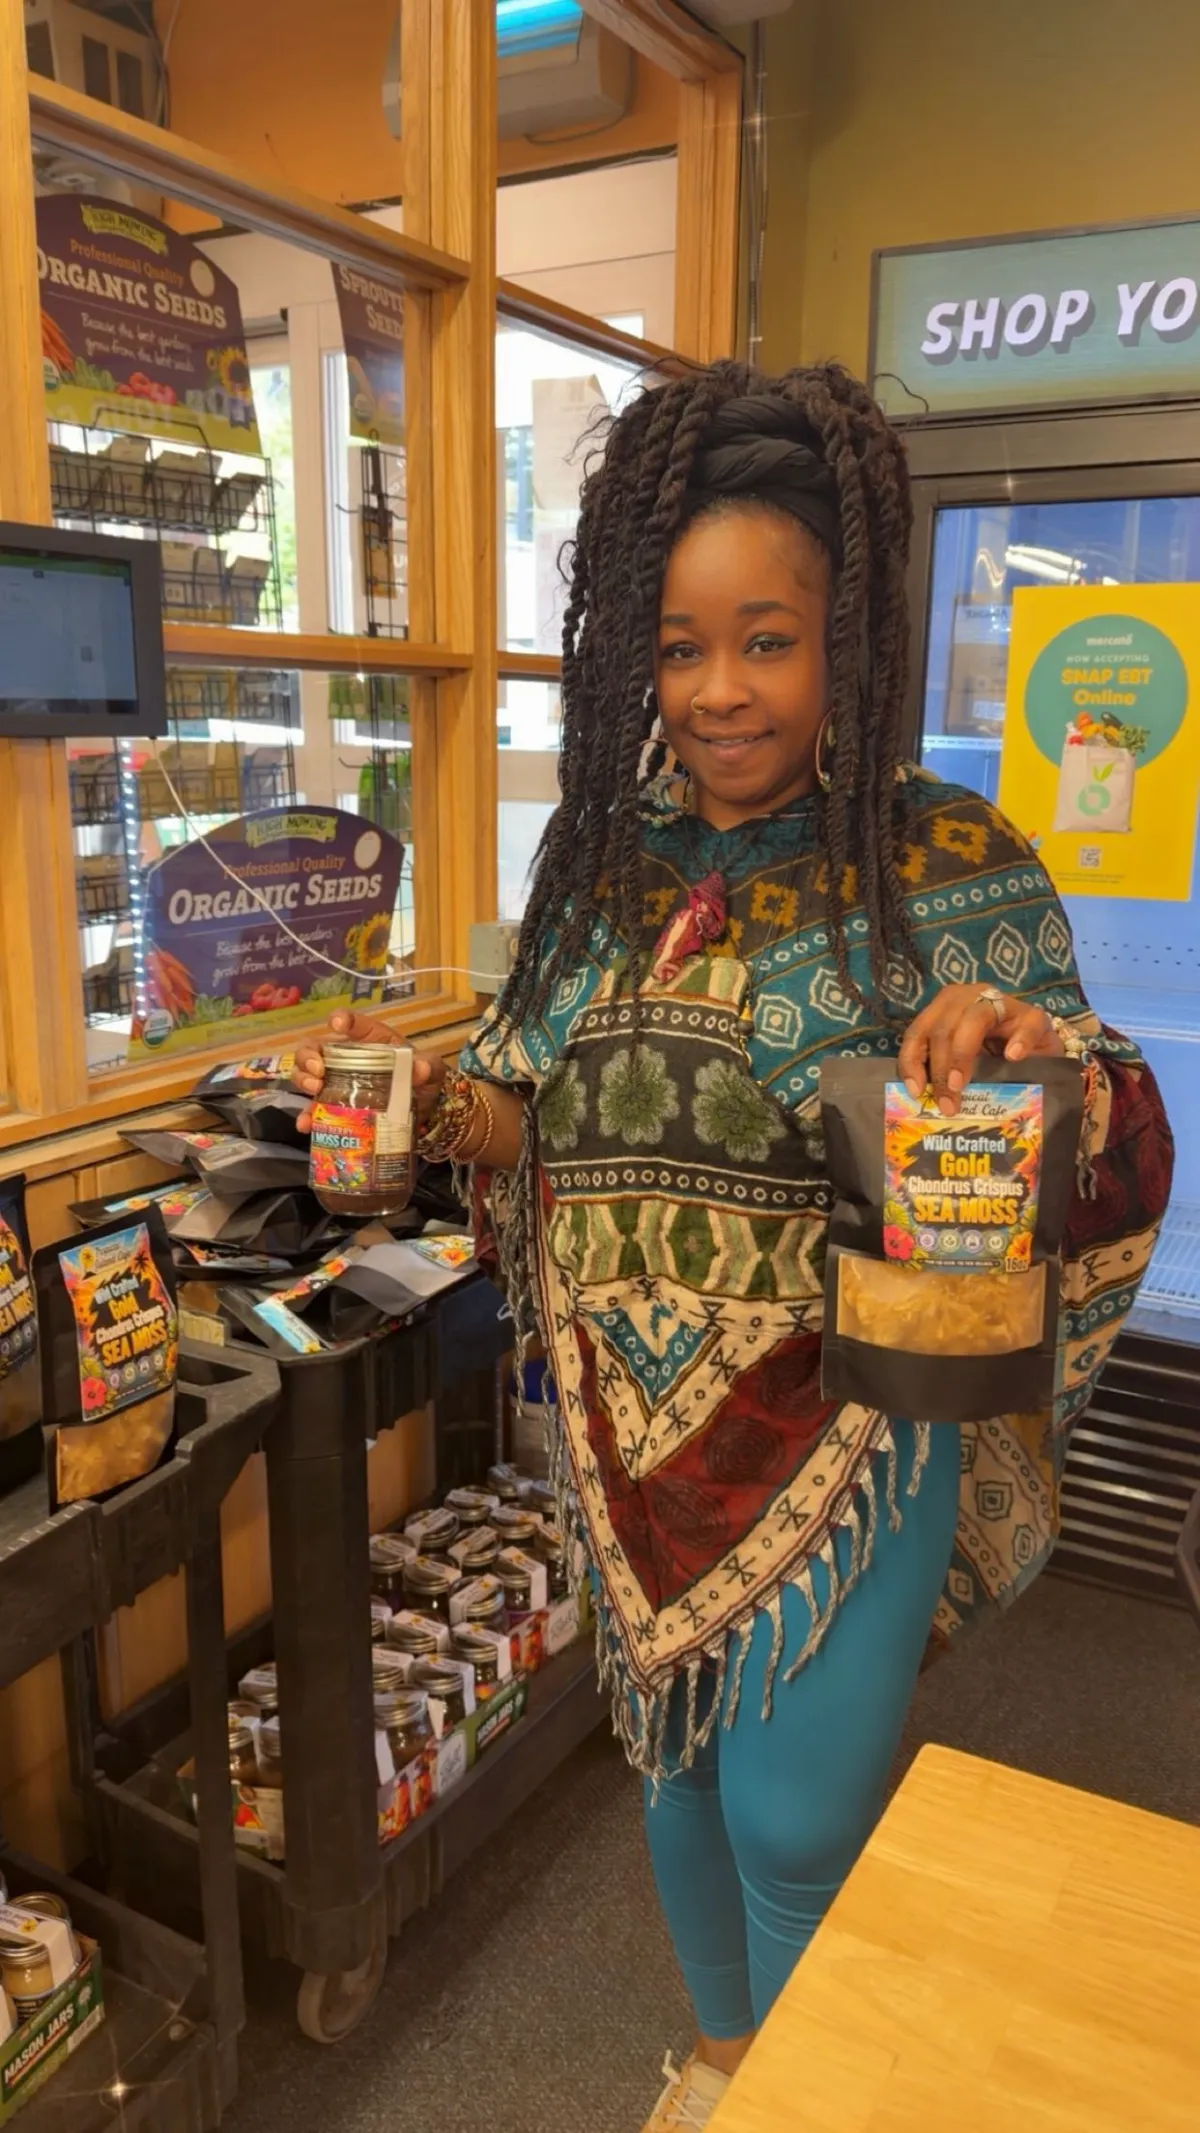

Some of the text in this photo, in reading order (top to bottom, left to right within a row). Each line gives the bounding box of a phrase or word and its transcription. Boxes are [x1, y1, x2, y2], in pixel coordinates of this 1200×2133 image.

[70, 238, 185, 289] Professional Quality
[36, 246, 227, 329] ORGANIC SEEDS
[920, 276, 1198, 356] SHOP YO
[1066, 653, 1150, 664] NOW ACCEPTING
[1061, 667, 1153, 686] SNAP EBT
[1072, 688, 1137, 706] Online
[302, 855, 346, 874] Quality
[168, 873, 383, 925] ORGANIC SEEDS
[242, 957, 269, 975] from
[341, 1136, 361, 1150] GEL
[923, 1135, 1006, 1153] Wild Crafted
[940, 1152, 991, 1177] Gold
[908, 1176, 1024, 1198] Chondrus Crispus
[914, 1195, 1018, 1225] SEA MOSS
[108, 1291, 139, 1321] Gold
[101, 1319, 168, 1367] SEA MOSS
[4, 2032, 45, 2084] MASON
[46, 2003, 76, 2043] JARS
